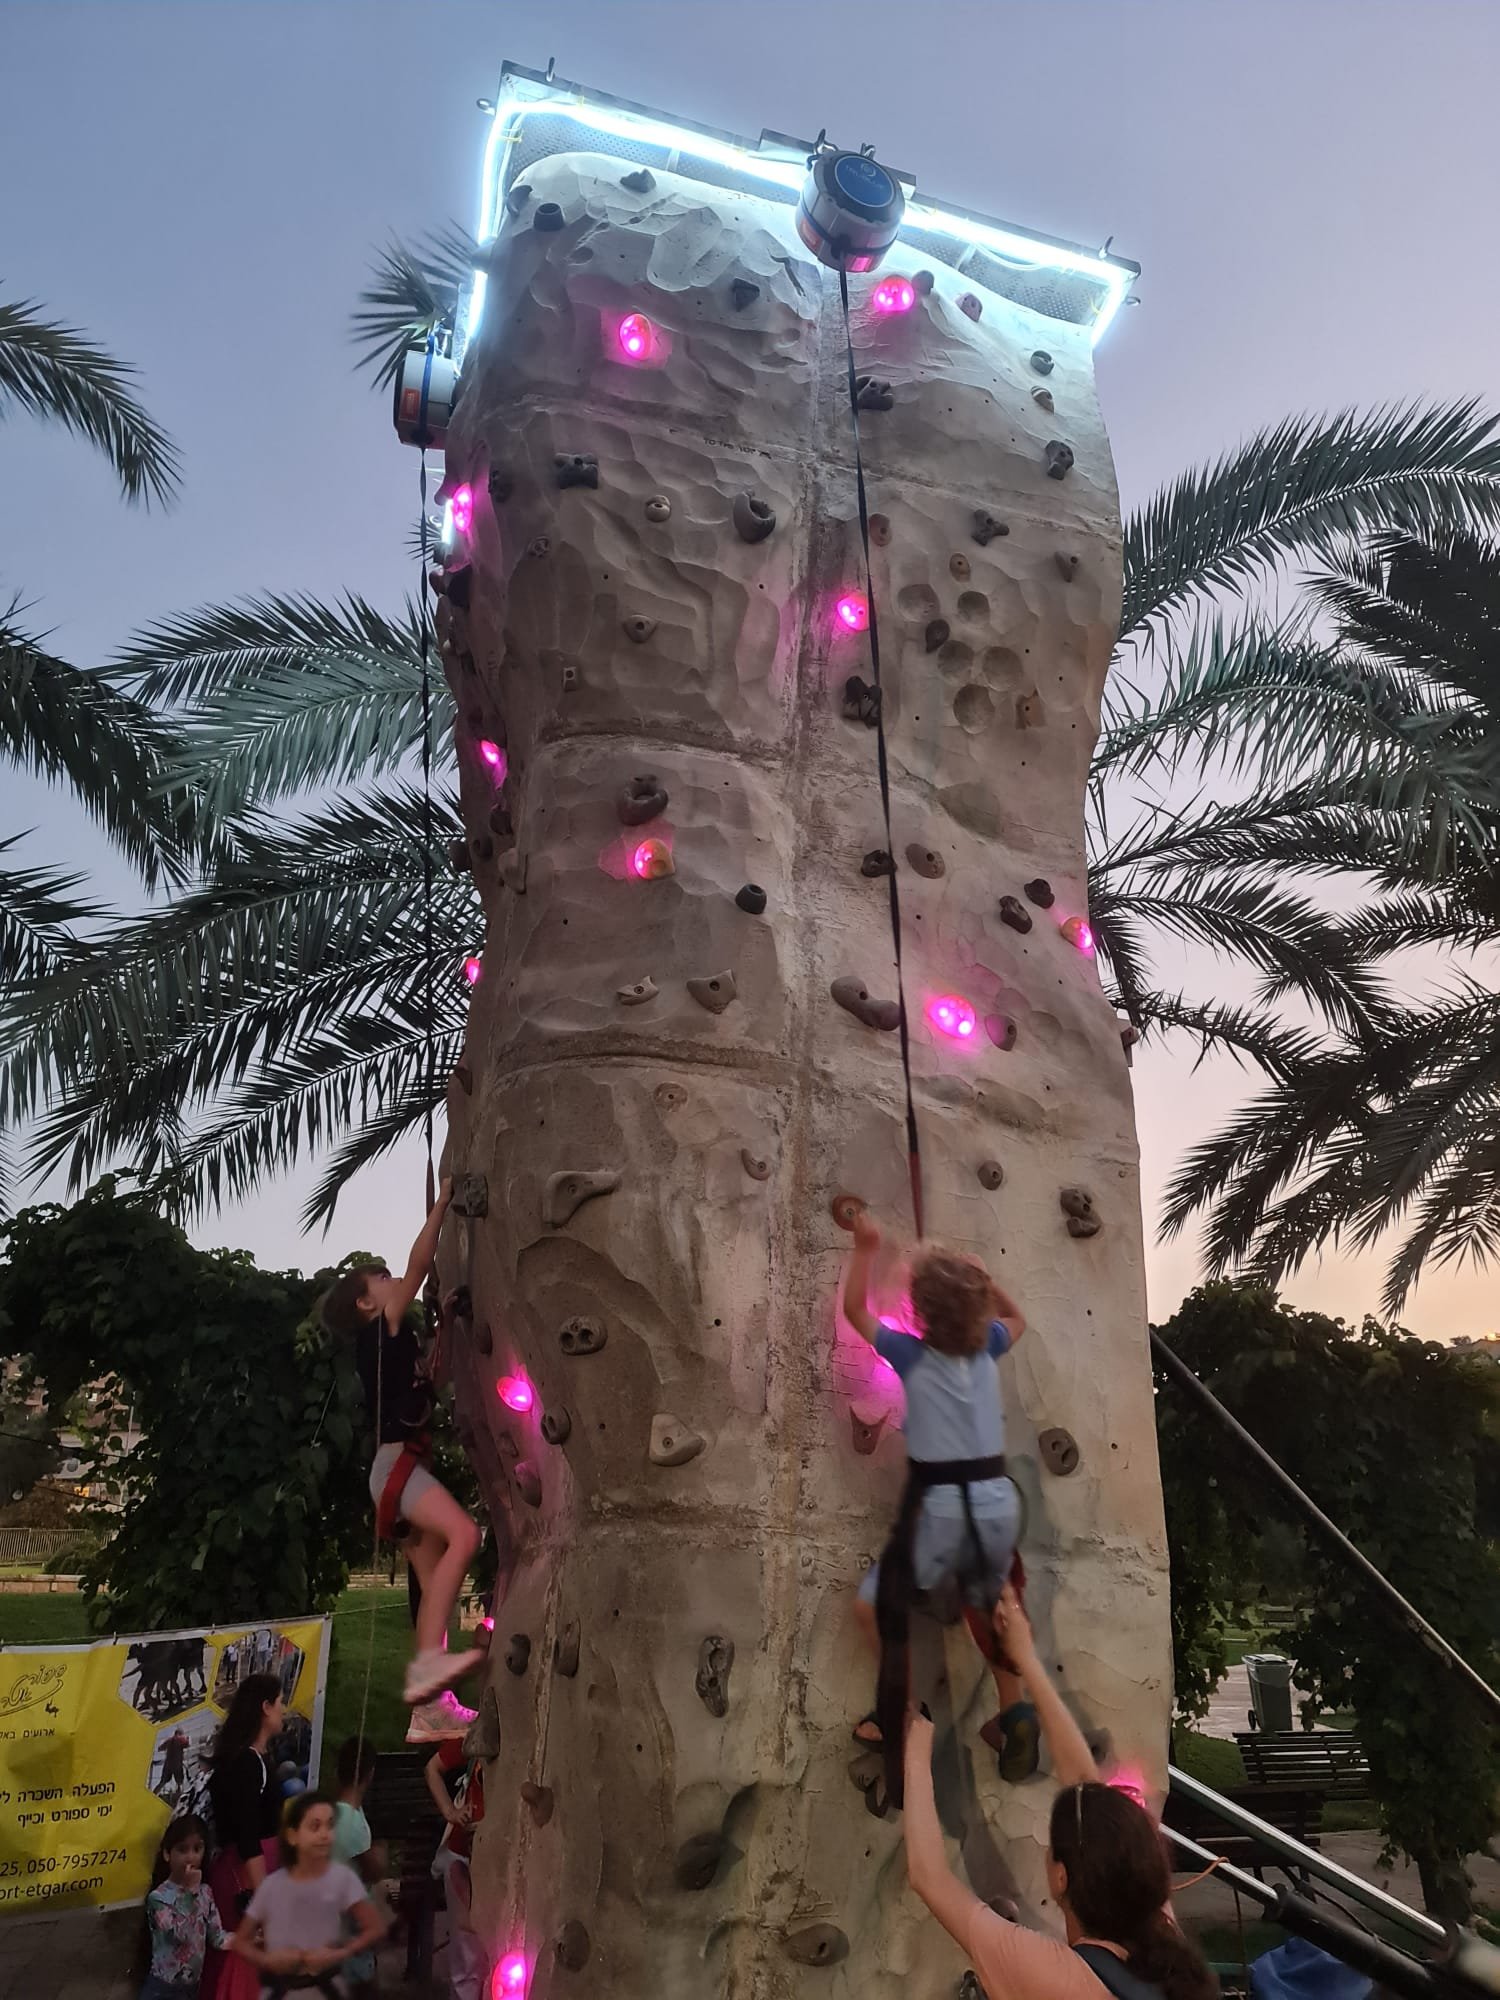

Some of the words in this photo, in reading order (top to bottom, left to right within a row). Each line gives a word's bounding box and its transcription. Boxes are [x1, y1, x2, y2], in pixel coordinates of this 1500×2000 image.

[23, 1727, 55, 1738] ארועים
[18, 1788, 63, 1803] השכרה
[72, 1782, 115, 1797] הפעלה
[51, 1808, 90, 1821] ספורט
[97, 1805, 112, 1817] ימי
[18, 1813, 44, 1828] וכייף
[27, 1849, 127, 1874] 050-7957274
